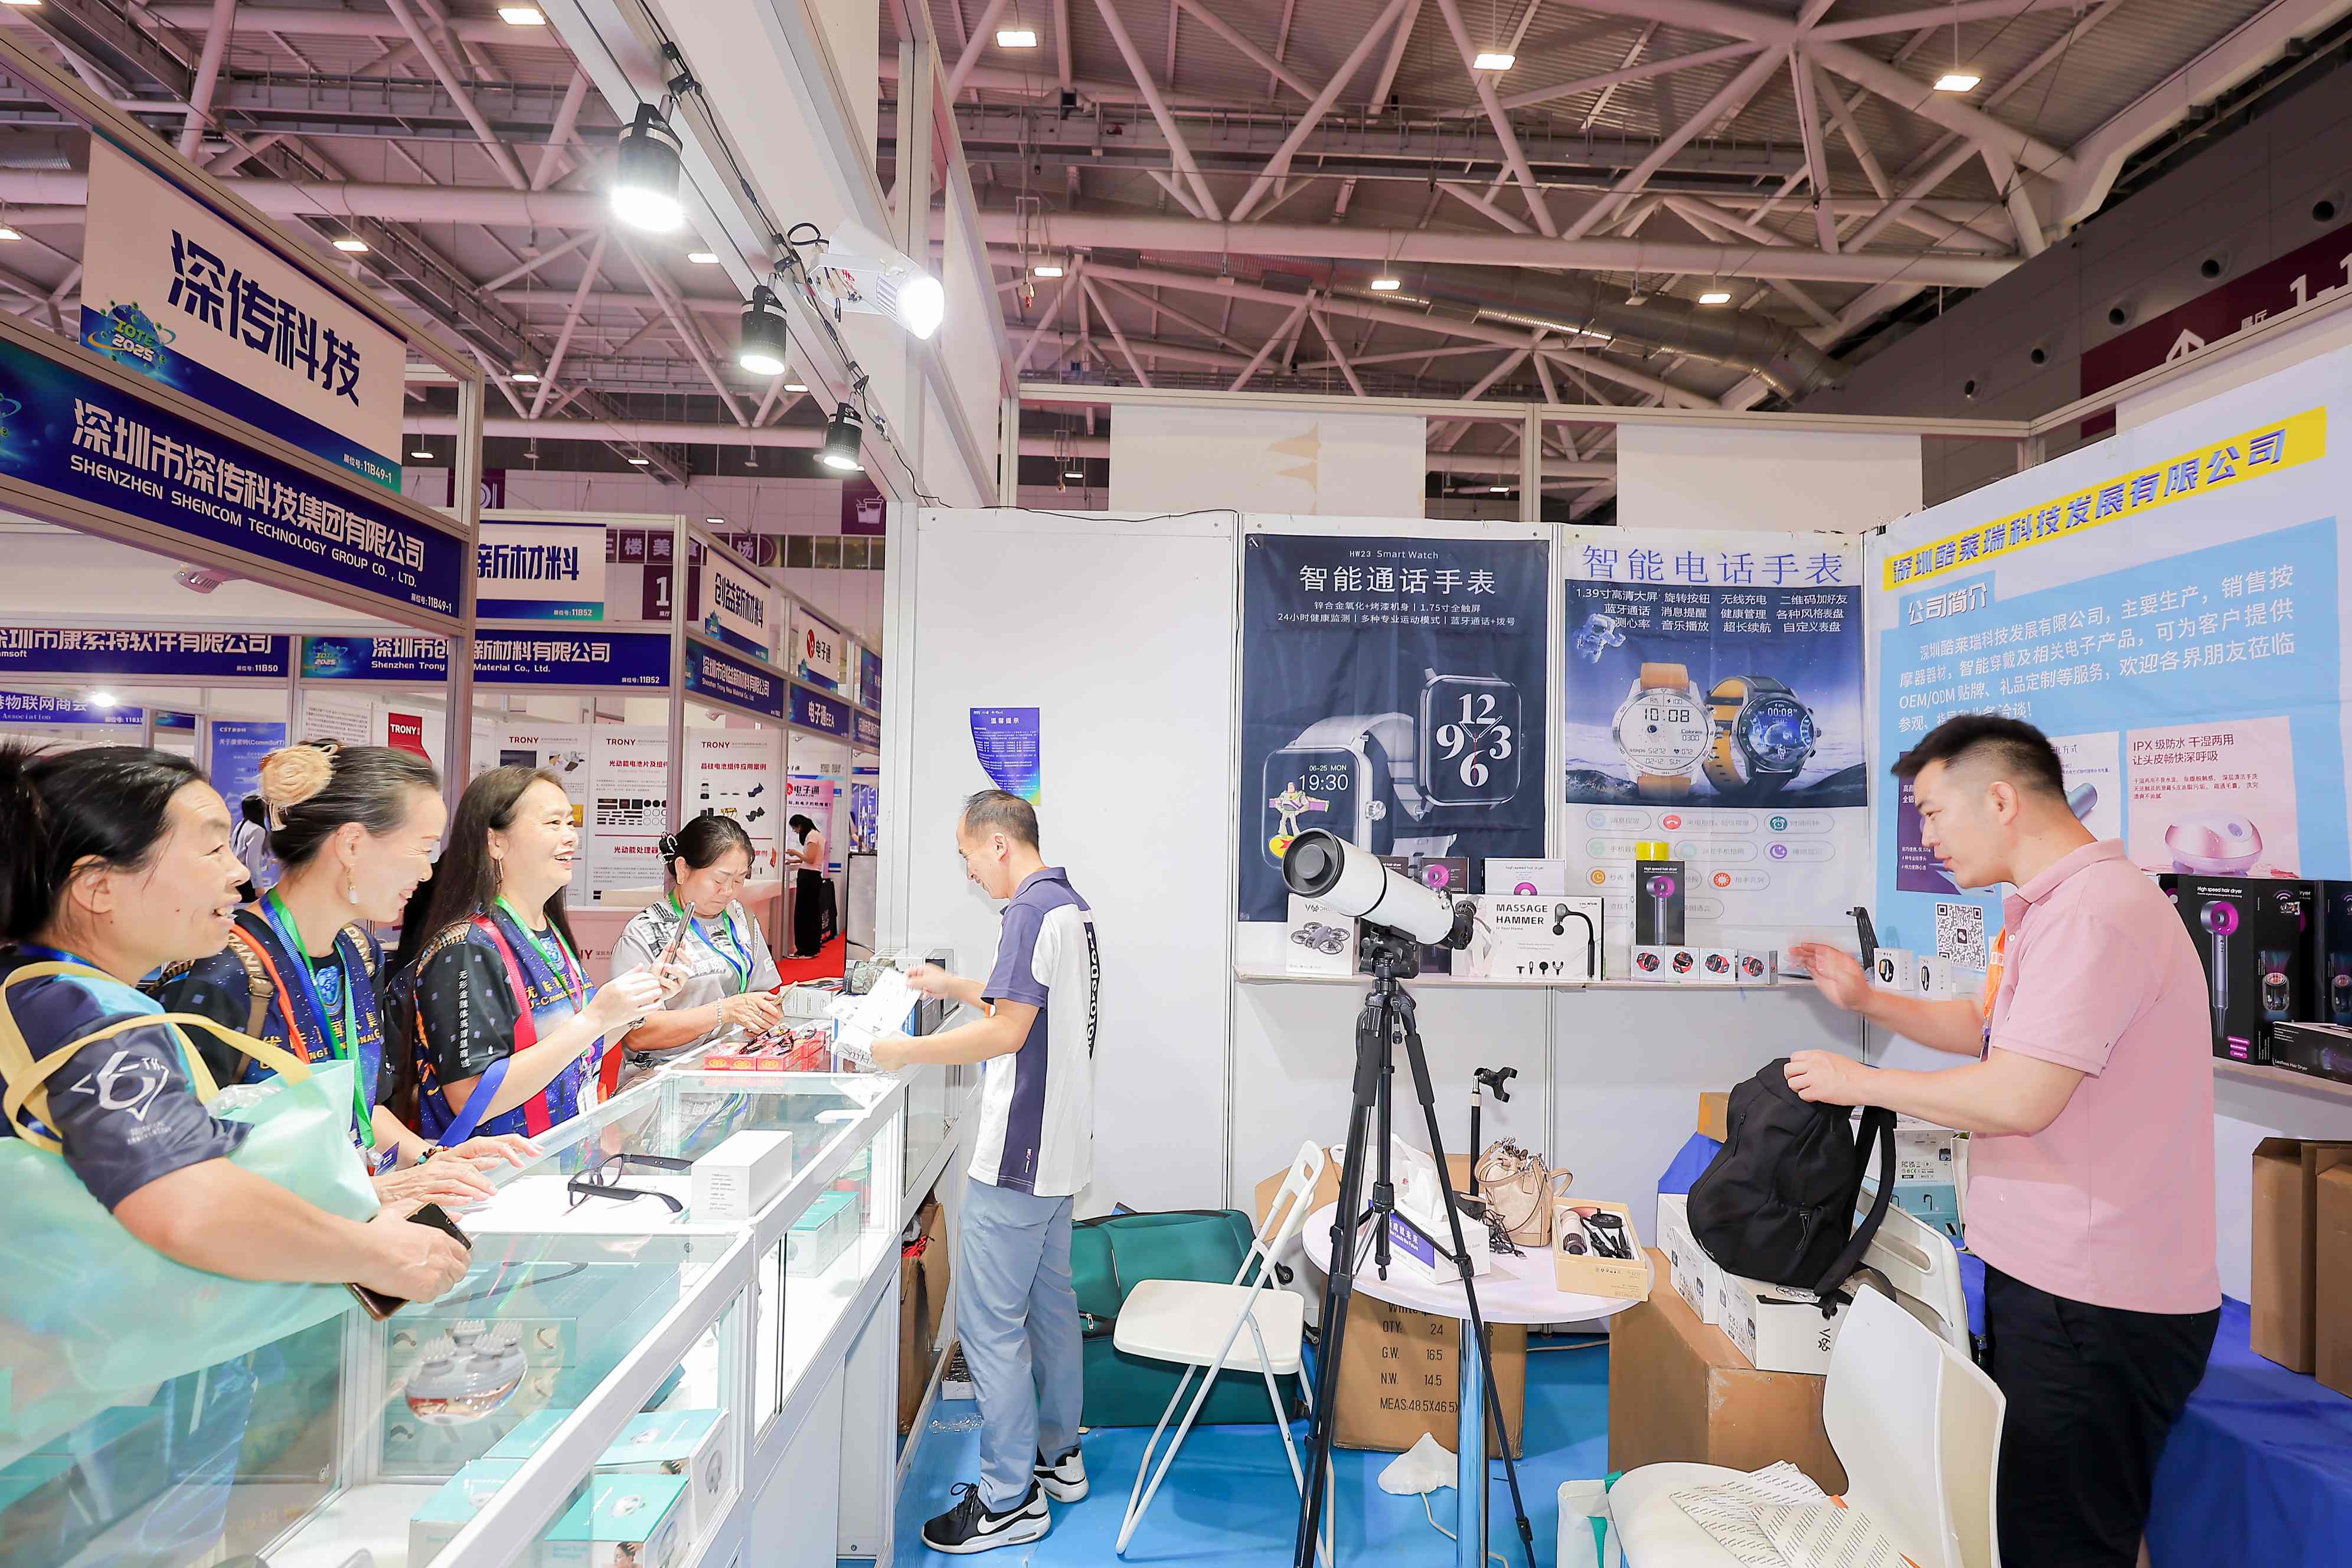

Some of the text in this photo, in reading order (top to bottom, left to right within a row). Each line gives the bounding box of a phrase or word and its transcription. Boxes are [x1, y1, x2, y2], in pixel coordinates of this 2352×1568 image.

[167, 229, 360, 407] 深传科技
[112, 334, 155, 362] 2025
[73, 398, 424, 571] 深圳市深传科技集团有限公司
[1892, 429, 2286, 583] 深圳酷莱瑞科技发展有限公司
[70, 455, 163, 500] SHENZHEN
[171, 490, 241, 527] SHENCOM
[249, 517, 326, 557] TECHNOLOGY
[332, 548, 368, 570] GROUP
[398, 570, 417, 589] LTD.
[1349, 550, 1439, 560] HW23 Smart Watch
[1582, 544, 1843, 584] 智能电话手表
[1299, 565, 1496, 596] 智能通话手表
[656, 576, 669, 606] 1
[715, 572, 763, 628] 创益新材料
[1576, 587, 1848, 606] 1.39寸高清大屏 旋转按钮 无线充电 二维码加好友
[1420, 602, 1481, 613] 1.75寸全触屏
[1604, 604, 1844, 620] 蓝牙通话 消息提醒 健康管理 各种风格表盘
[1908, 582, 1988, 626] 公司简介
[1277, 612, 1351, 623] 24小时健康监测
[1360, 613, 1440, 626] 多种专业运动模式
[1615, 617, 1841, 633] 测心率 音乐播放 超长续航 自定义表盘
[371, 661, 551, 673] Shenzhen Trony Material Co., Ltd.
[1899, 687, 1955, 710] OEM/ODM
[2, 713, 51, 721] Association
[1458, 693, 1497, 725] 12
[1645, 708, 1690, 723] 10:08
[390, 723, 417, 736] TRONY
[1436, 724, 1513, 760] 9 3
[2133, 734, 2235, 752] IPX 级防水 干湿两用
[2132, 750, 2219, 766] 让头皮畅快深呼吸
[1459, 749, 1489, 788] 6
[1299, 773, 1349, 792] 19:30
[1496, 903, 1548, 913] MASSAGE
[1496, 916, 1544, 925] HAMMER
[1430, 1324, 1444, 1336] 24
[1382, 1346, 1443, 1361] G.W. 16.5
[1381, 1373, 1442, 1386] N.W. 14.5
